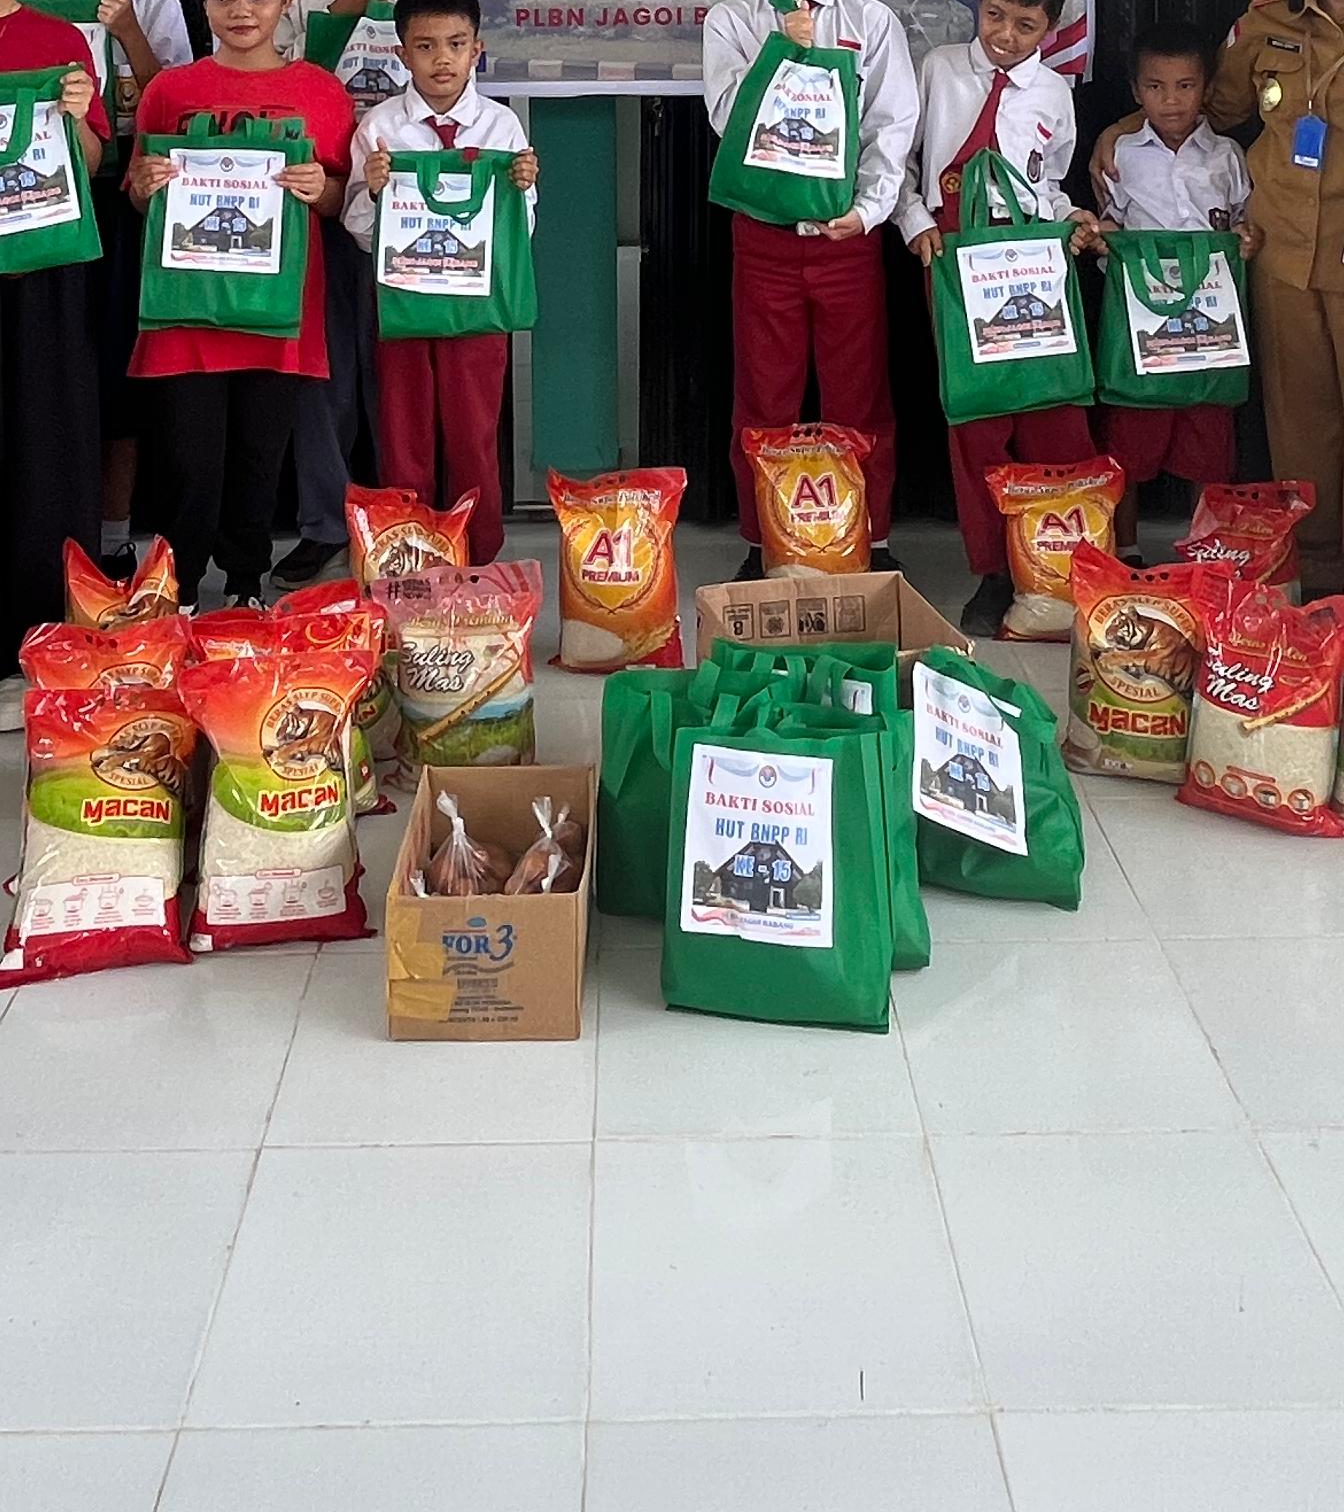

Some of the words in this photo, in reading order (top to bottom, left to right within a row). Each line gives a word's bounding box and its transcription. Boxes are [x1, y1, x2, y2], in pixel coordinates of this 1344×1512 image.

[515, 8, 585, 28] PLBN
[596, 6, 683, 28] JAGOI
[791, 474, 838, 508] A1
[1037, 508, 1086, 536] A1
[583, 528, 633, 568] A1
[401, 641, 475, 673] Suling
[407, 667, 465, 694] Mas
[1206, 675, 1260, 711] Mas
[926, 703, 961, 730] BAKTI
[705, 791, 758, 812] BAKTI
[761, 799, 816, 816] SOSIAL
[716, 817, 745, 839] HUT
[750, 822, 790, 845] BNPP
[771, 859, 792, 883] 15
